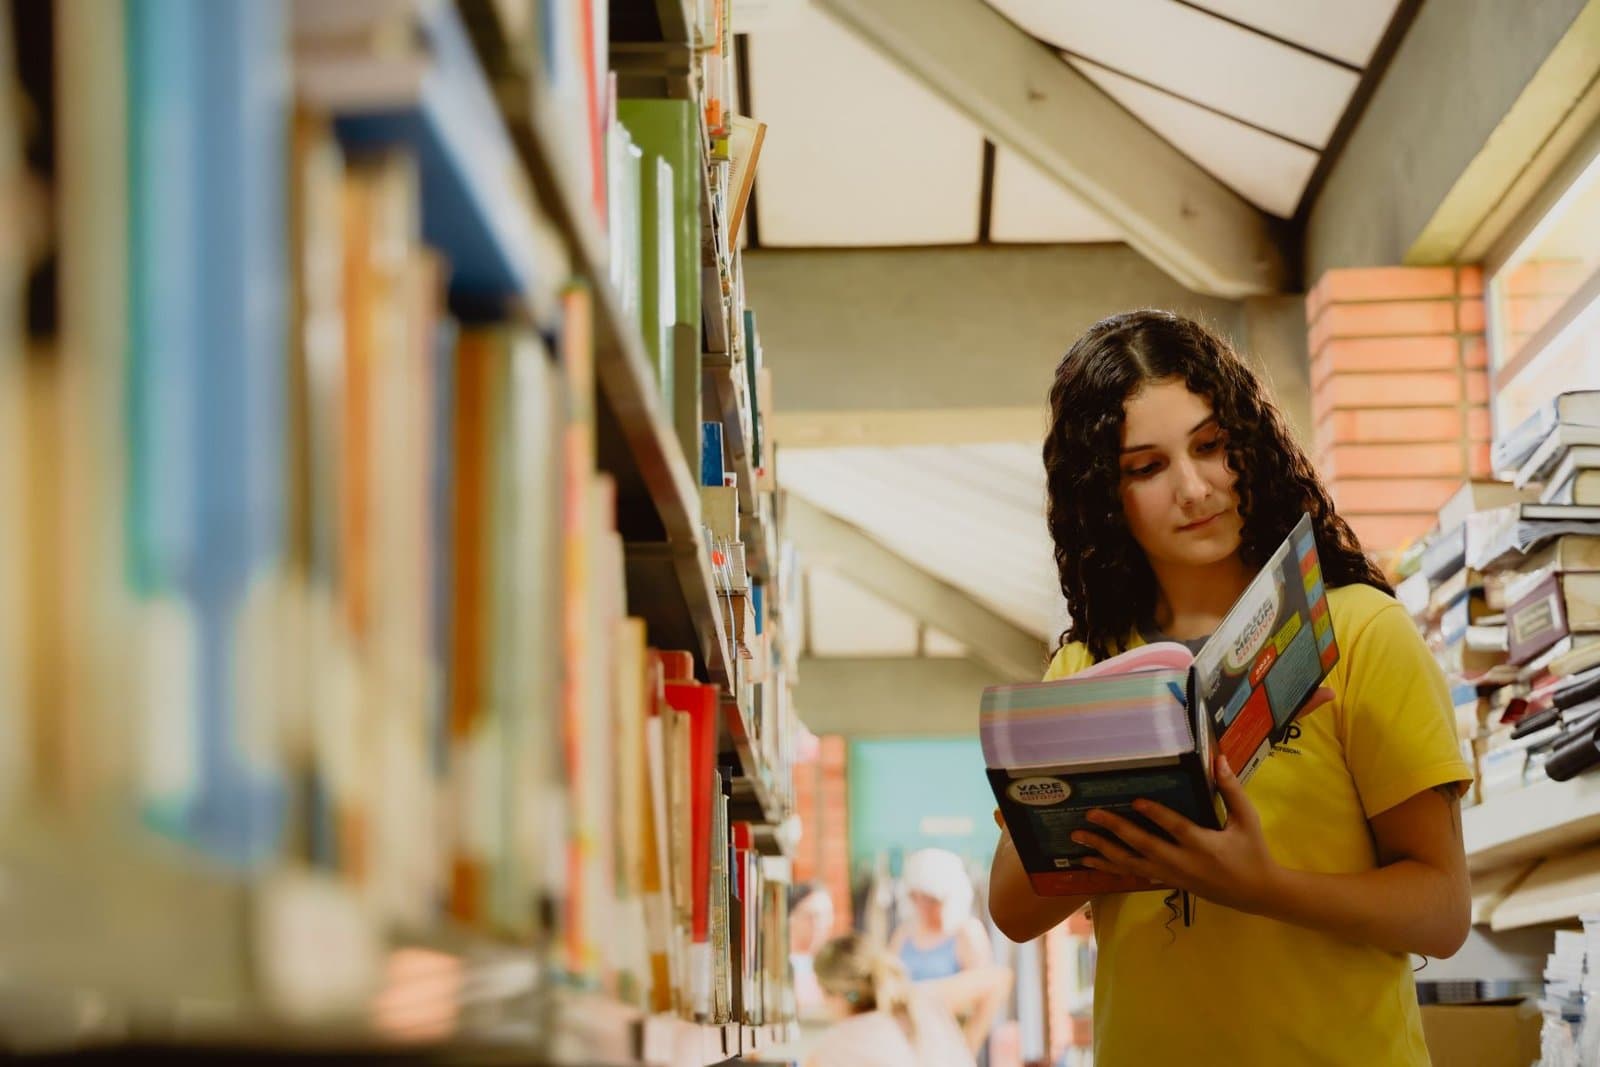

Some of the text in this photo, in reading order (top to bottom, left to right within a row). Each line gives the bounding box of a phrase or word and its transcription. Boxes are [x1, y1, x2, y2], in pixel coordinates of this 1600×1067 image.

[1235, 602, 1273, 656] MECUM
[1016, 782, 1062, 791] VADE
[1019, 788, 1064, 796] MECUM
